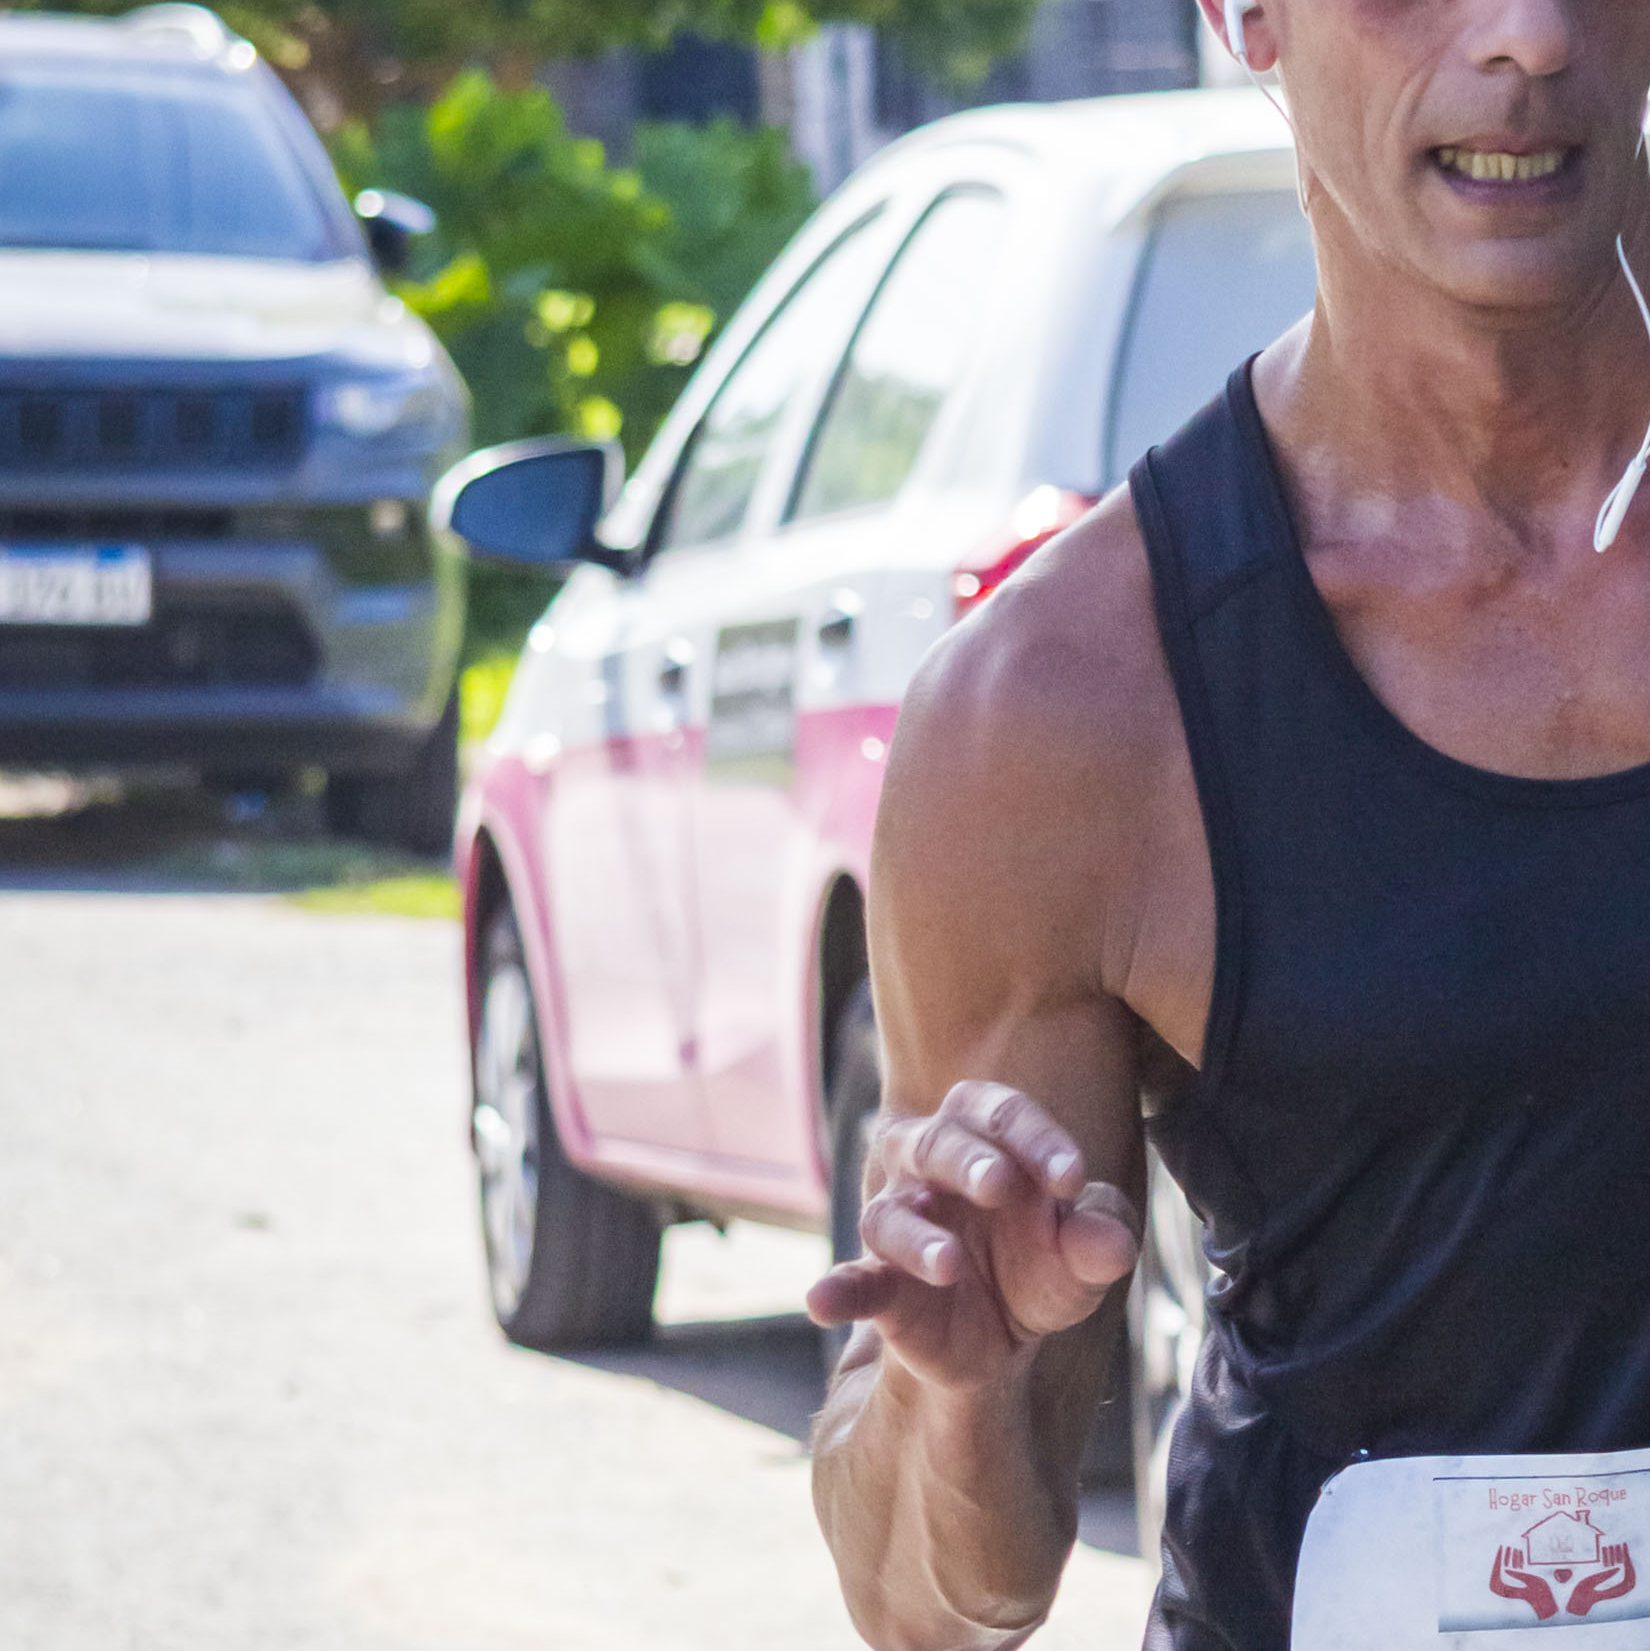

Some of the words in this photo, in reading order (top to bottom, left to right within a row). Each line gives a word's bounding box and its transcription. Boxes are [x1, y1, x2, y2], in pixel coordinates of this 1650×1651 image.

[1488, 1488, 1537, 1511] Hogar
[1543, 1488, 1571, 1509] San
[1575, 1487, 1627, 1507] Roque
